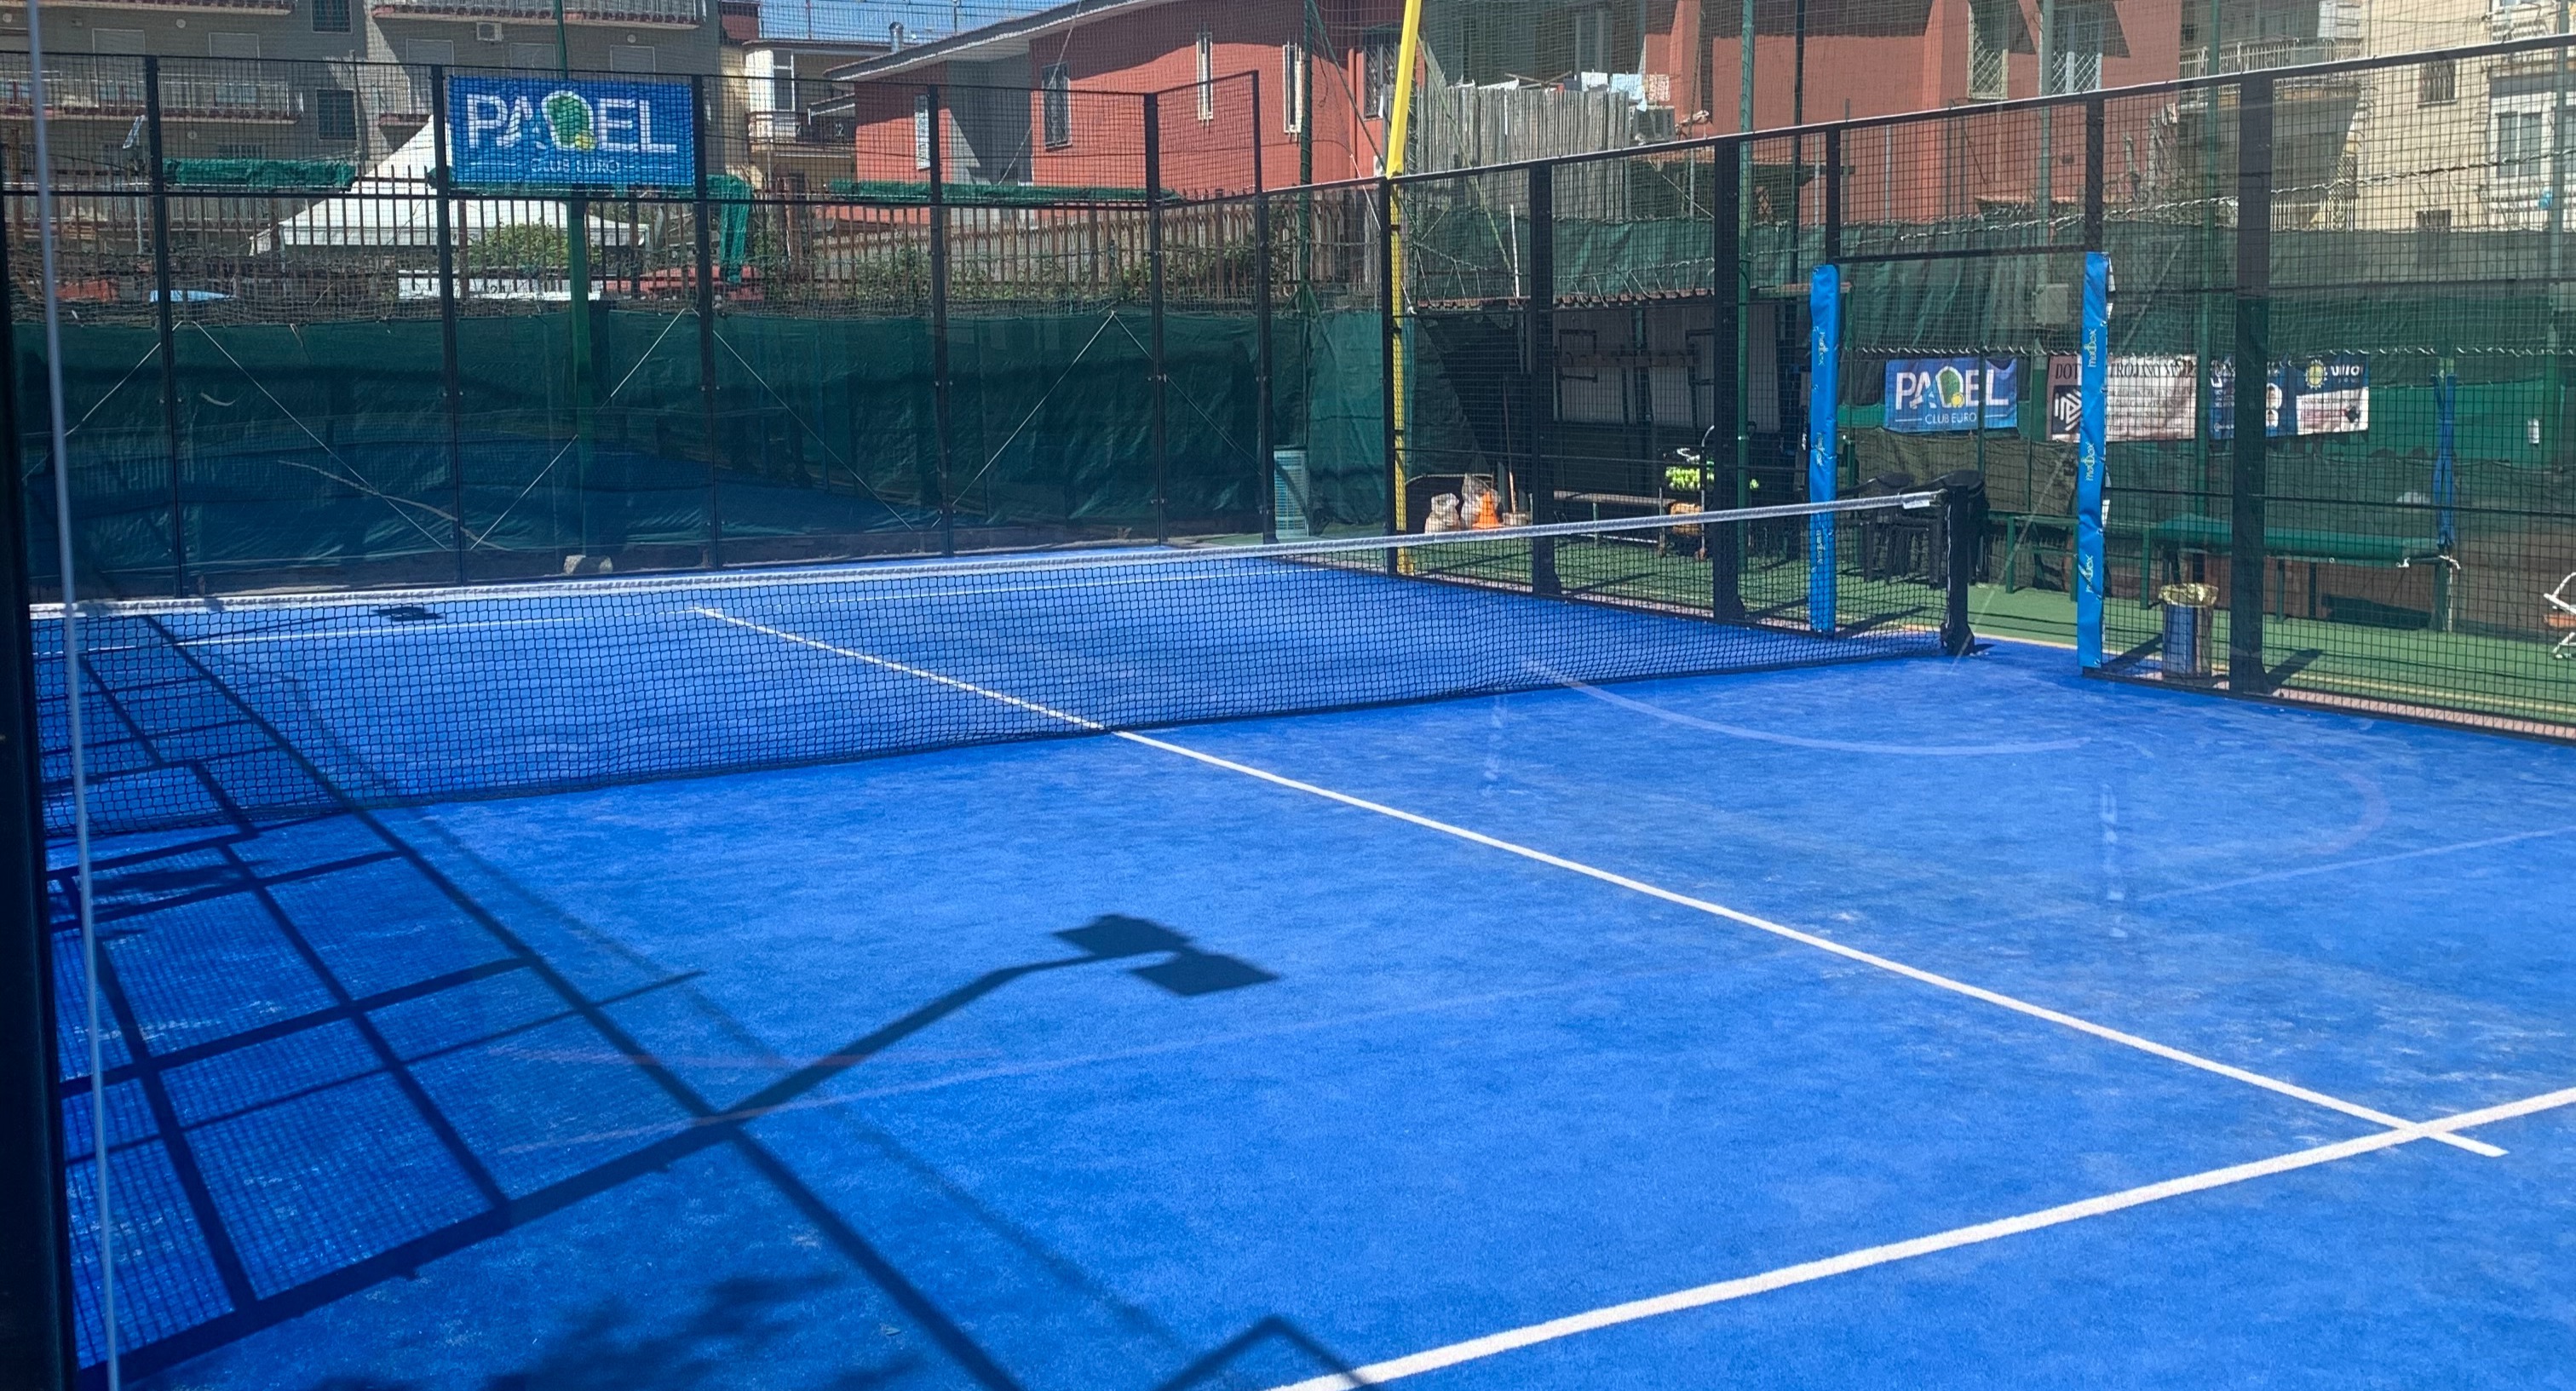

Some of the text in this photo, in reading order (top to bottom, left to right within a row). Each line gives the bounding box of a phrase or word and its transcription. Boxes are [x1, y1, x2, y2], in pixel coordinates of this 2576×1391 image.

[530, 158, 620, 174] CLUB EURO
[1924, 412, 1977, 425] CLUB EURO
